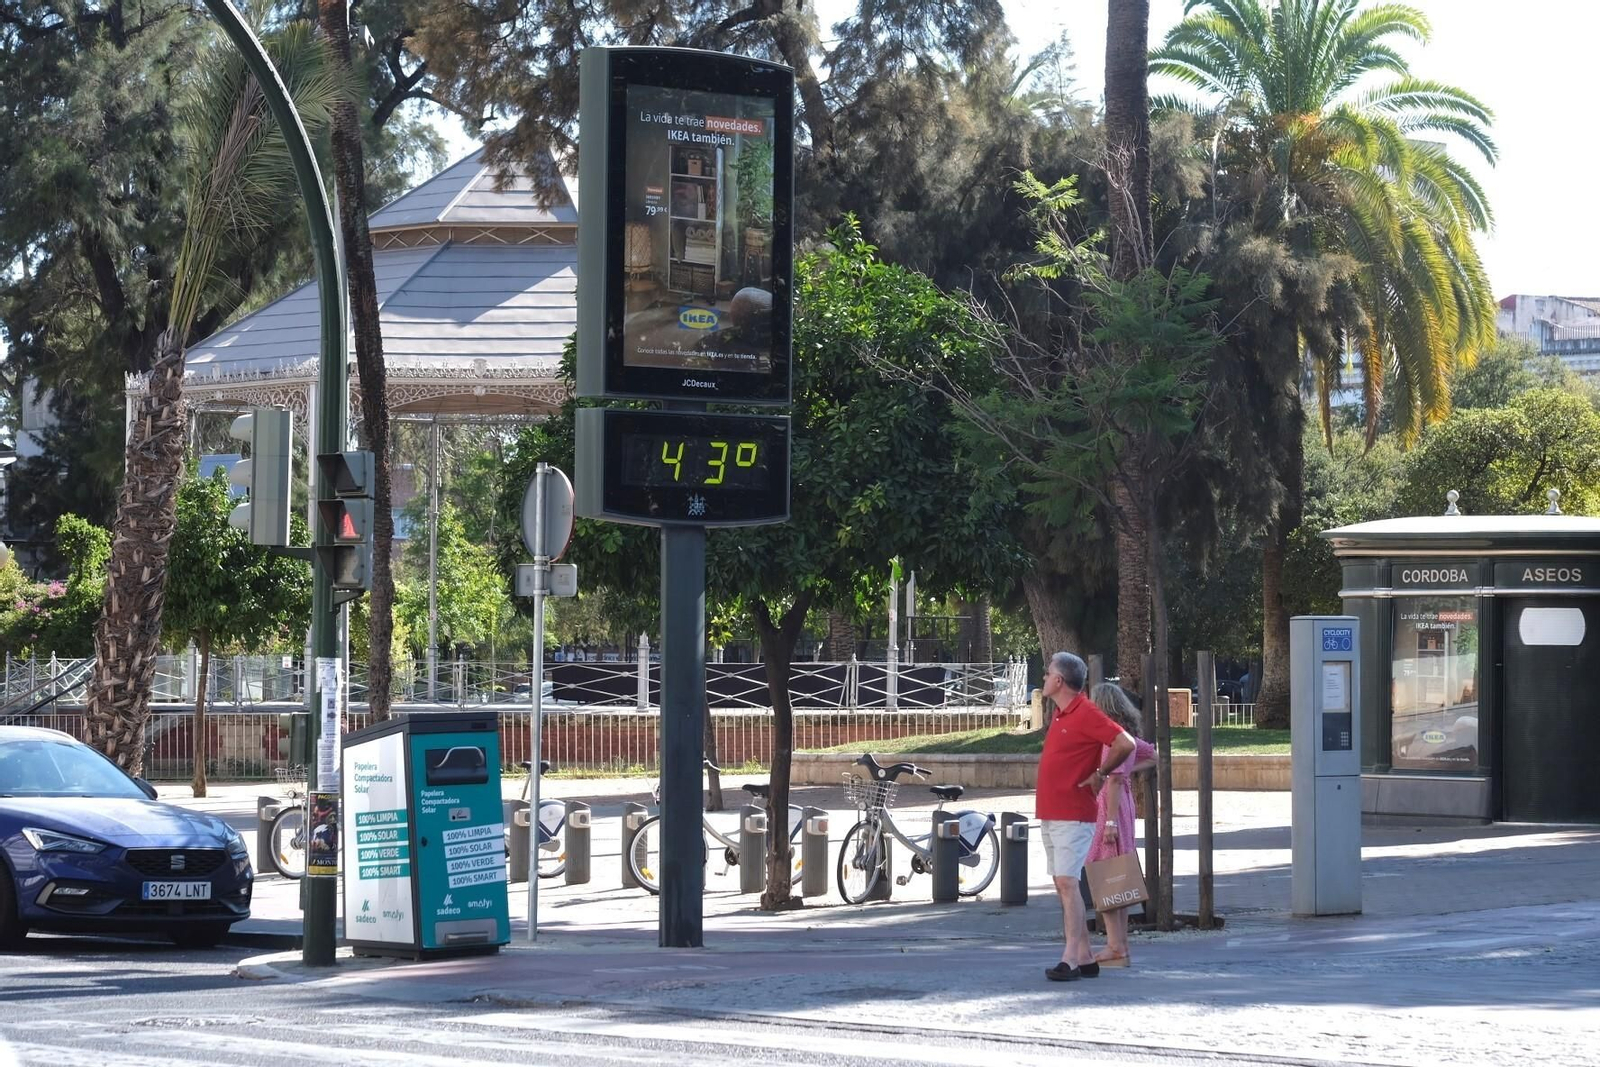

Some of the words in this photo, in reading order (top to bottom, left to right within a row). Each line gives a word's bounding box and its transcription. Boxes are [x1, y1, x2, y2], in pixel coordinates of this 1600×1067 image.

[640, 111, 650, 122] La
[653, 113, 673, 124] vida
[675, 116, 684, 126] te
[686, 117, 704, 127] trae
[707, 119, 761, 133] novedades.
[667, 129, 690, 141] IKEA
[692, 132, 735, 145] también.
[683, 313, 715, 324] IKEA
[682, 379, 716, 388] JCDecaux
[1402, 569, 1469, 583] CORDOBA
[1521, 568, 1582, 582] ASEOS
[1439, 612, 1473, 620] novedades.
[1415, 622, 1429, 630] IKEA
[354, 761, 377, 772] Papelera
[354, 773, 393, 784] Compactadora
[354, 784, 369, 793] Solar
[421, 790, 444, 798] Papelera
[421, 797, 460, 806] Compactadora
[421, 806, 436, 814] Solar
[358, 814, 376, 824] 100%
[376, 812, 398, 823] LIMPIA
[360, 832, 377, 842] 100%
[377, 830, 398, 840] SOLAR
[447, 830, 467, 840] 100%
[468, 827, 492, 837] LIMPIA
[361, 849, 378, 860] 100%
[379, 847, 400, 858] VERDE
[449, 846, 468, 855] 100%
[470, 842, 492, 852] SOLAR
[451, 860, 471, 870] 100%
[472, 857, 495, 867] VERDE
[362, 867, 379, 877] 100%
[380, 865, 401, 876] SMART
[453, 875, 473, 886] 100%
[473, 871, 497, 882] SMART
[151, 884, 181, 897] 3674
[186, 884, 207, 897] LNT
[1102, 888, 1141, 907] INSIDE
[436, 906, 461, 915] sadeco
[355, 914, 376, 923] sadeco
